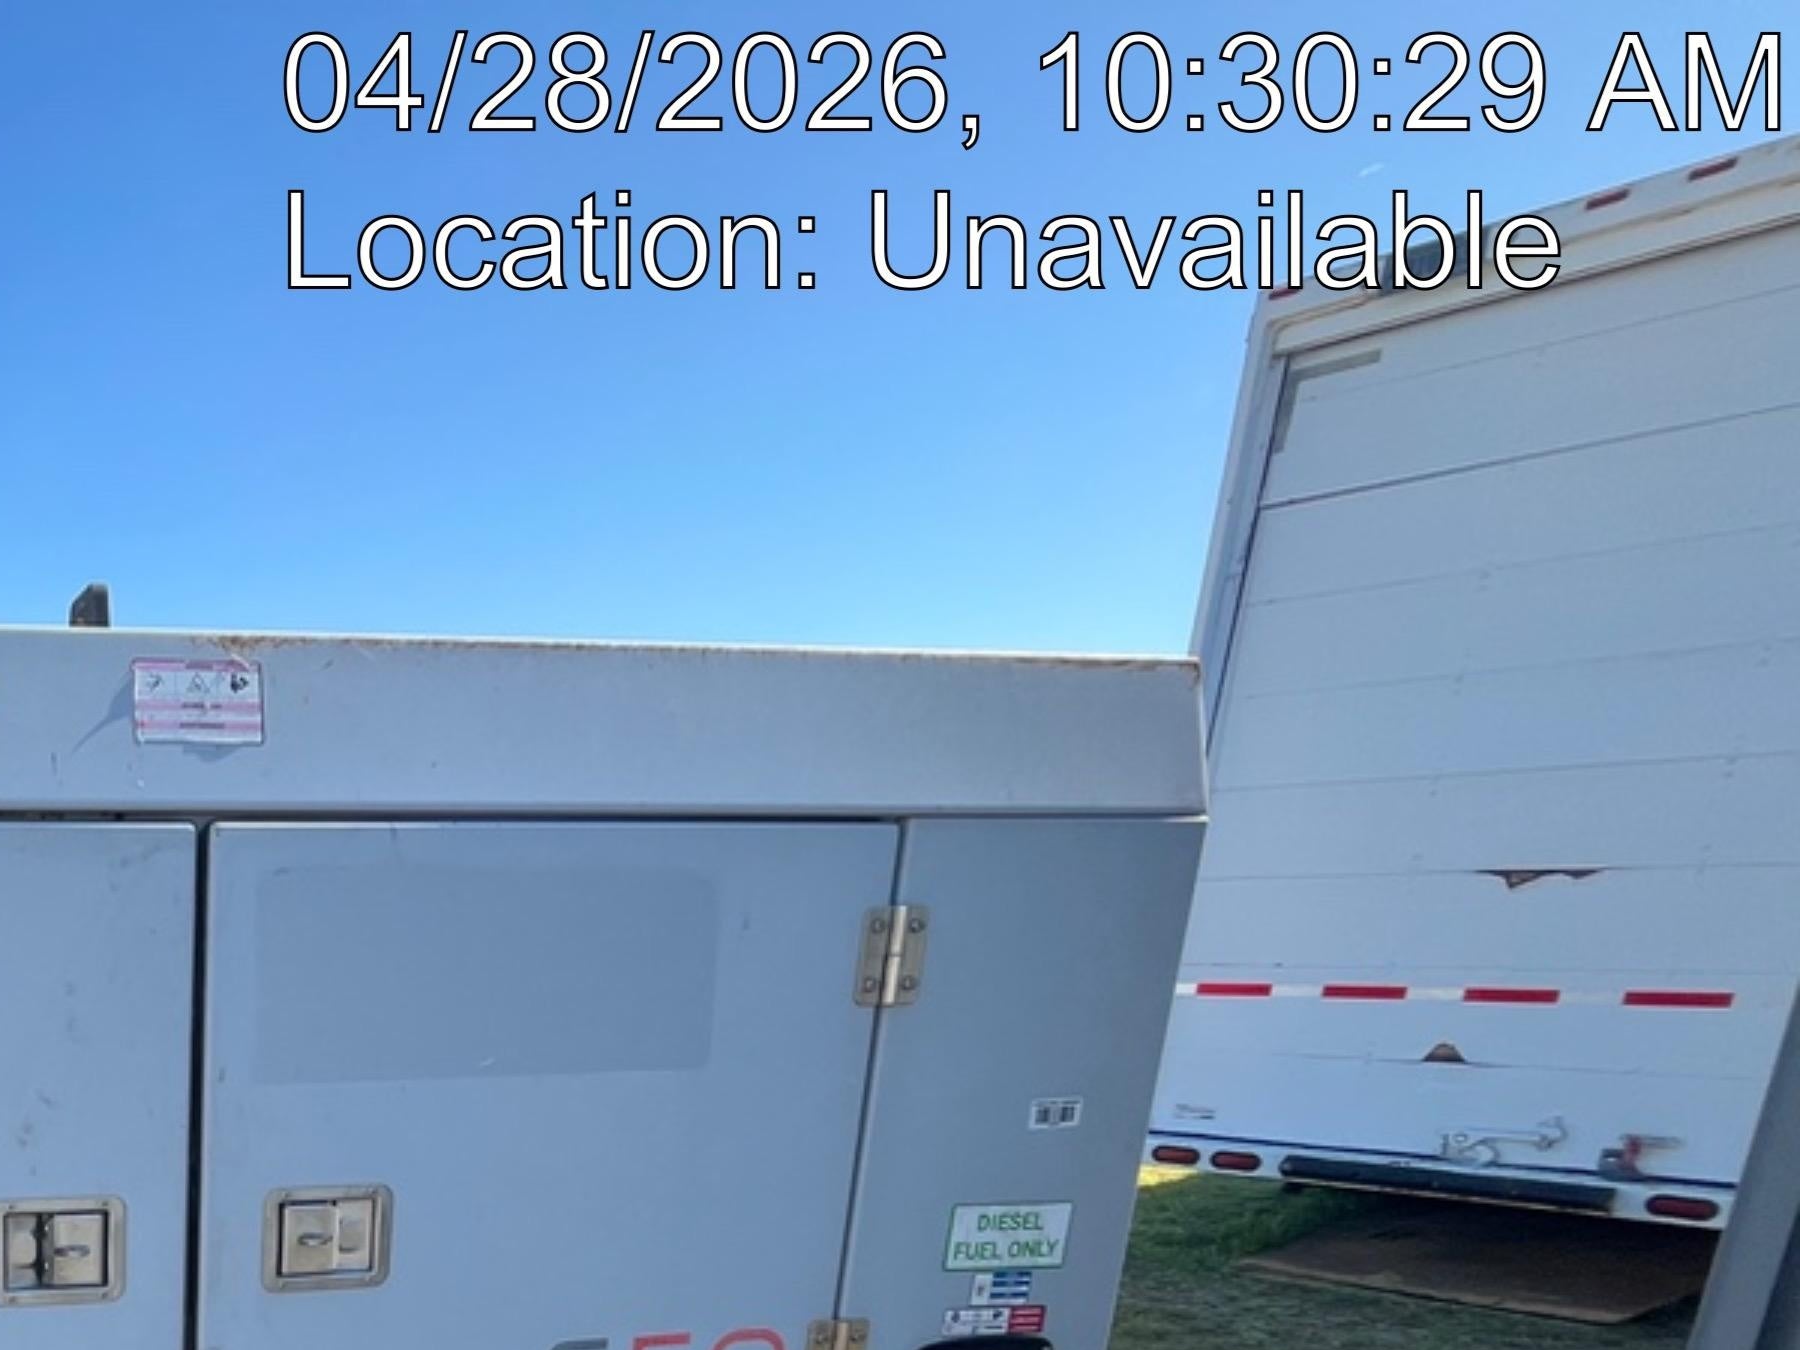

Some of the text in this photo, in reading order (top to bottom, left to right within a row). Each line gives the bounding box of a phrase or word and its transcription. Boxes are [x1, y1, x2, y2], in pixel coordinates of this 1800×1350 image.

[976, 1211, 1044, 1231] DIESEL
[953, 1238, 1061, 1261] FUEL ONLY
